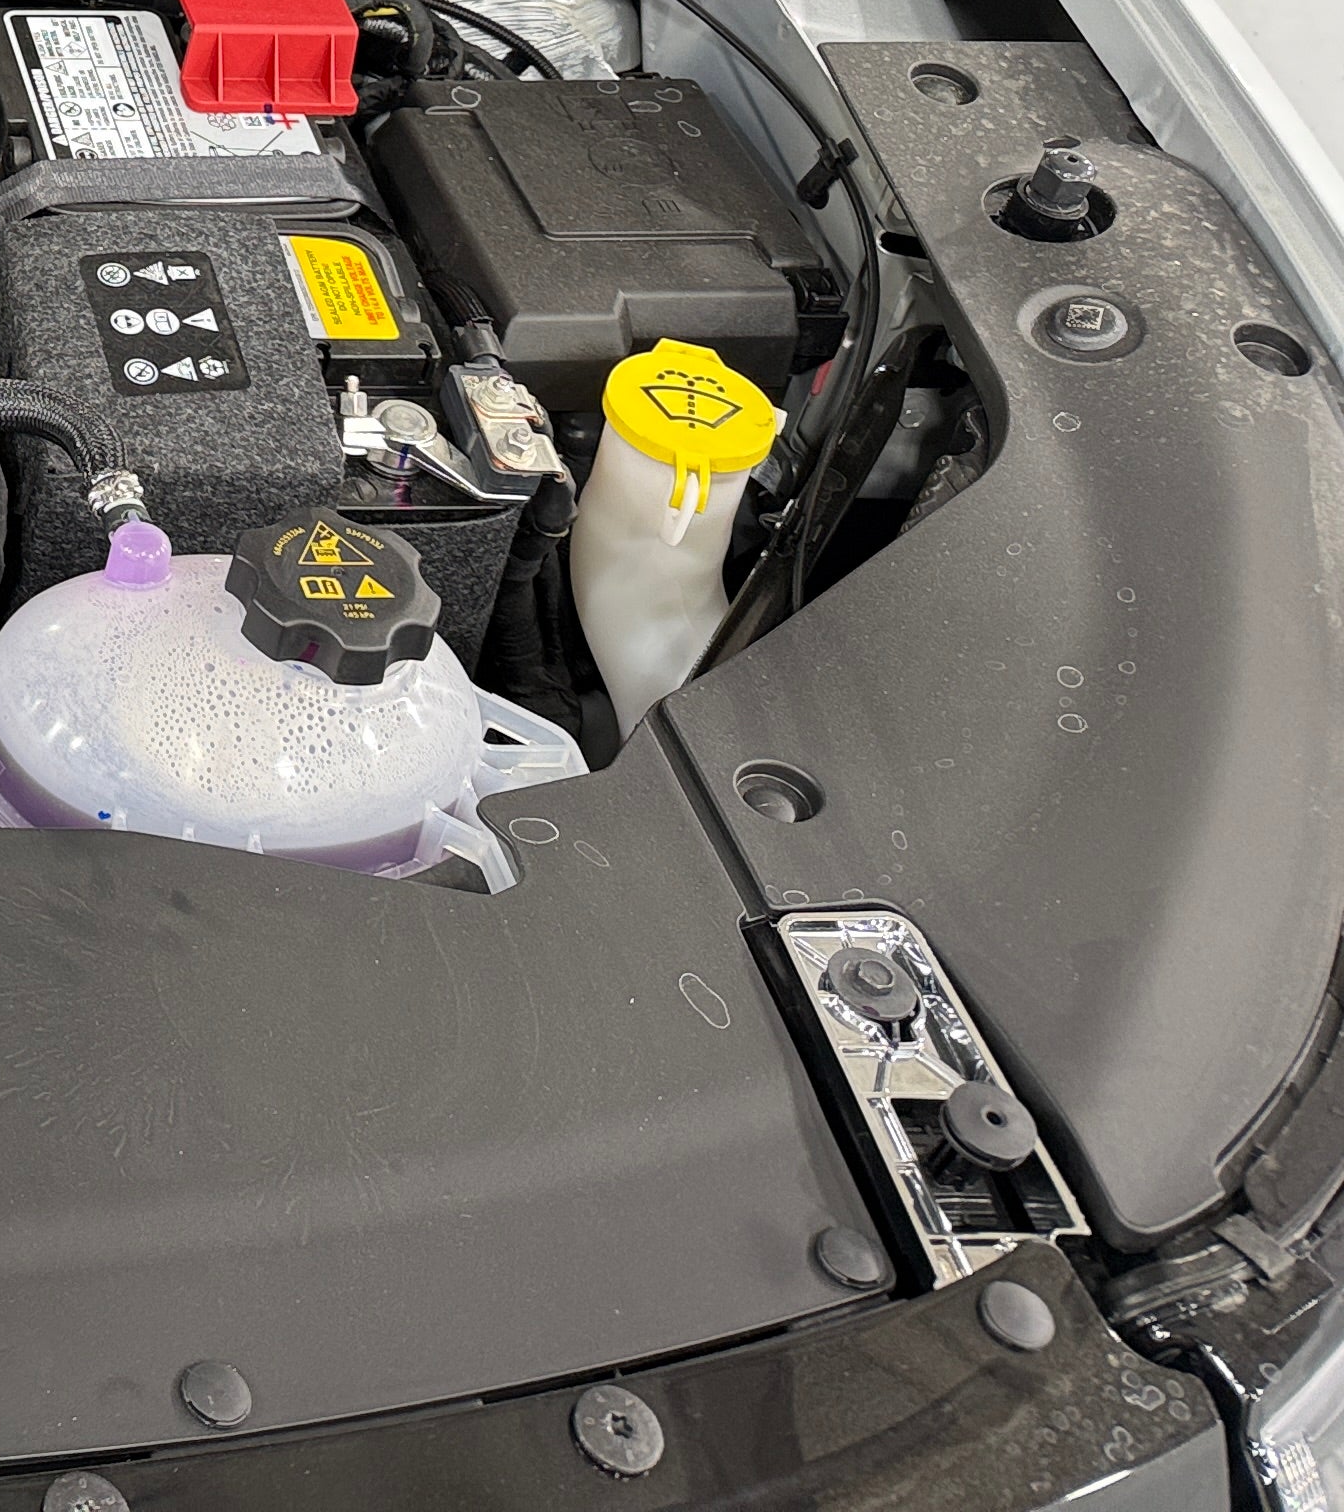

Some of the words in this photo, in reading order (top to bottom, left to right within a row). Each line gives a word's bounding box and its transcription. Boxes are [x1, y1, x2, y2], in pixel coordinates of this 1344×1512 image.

[305, 249, 323, 280] BATTERY
[317, 281, 331, 297] AGM
[330, 285, 342, 300] NOT
[332, 261, 362, 317] NON-SPILLABLE
[325, 297, 342, 325] SEALED
[336, 300, 347, 312] DO
